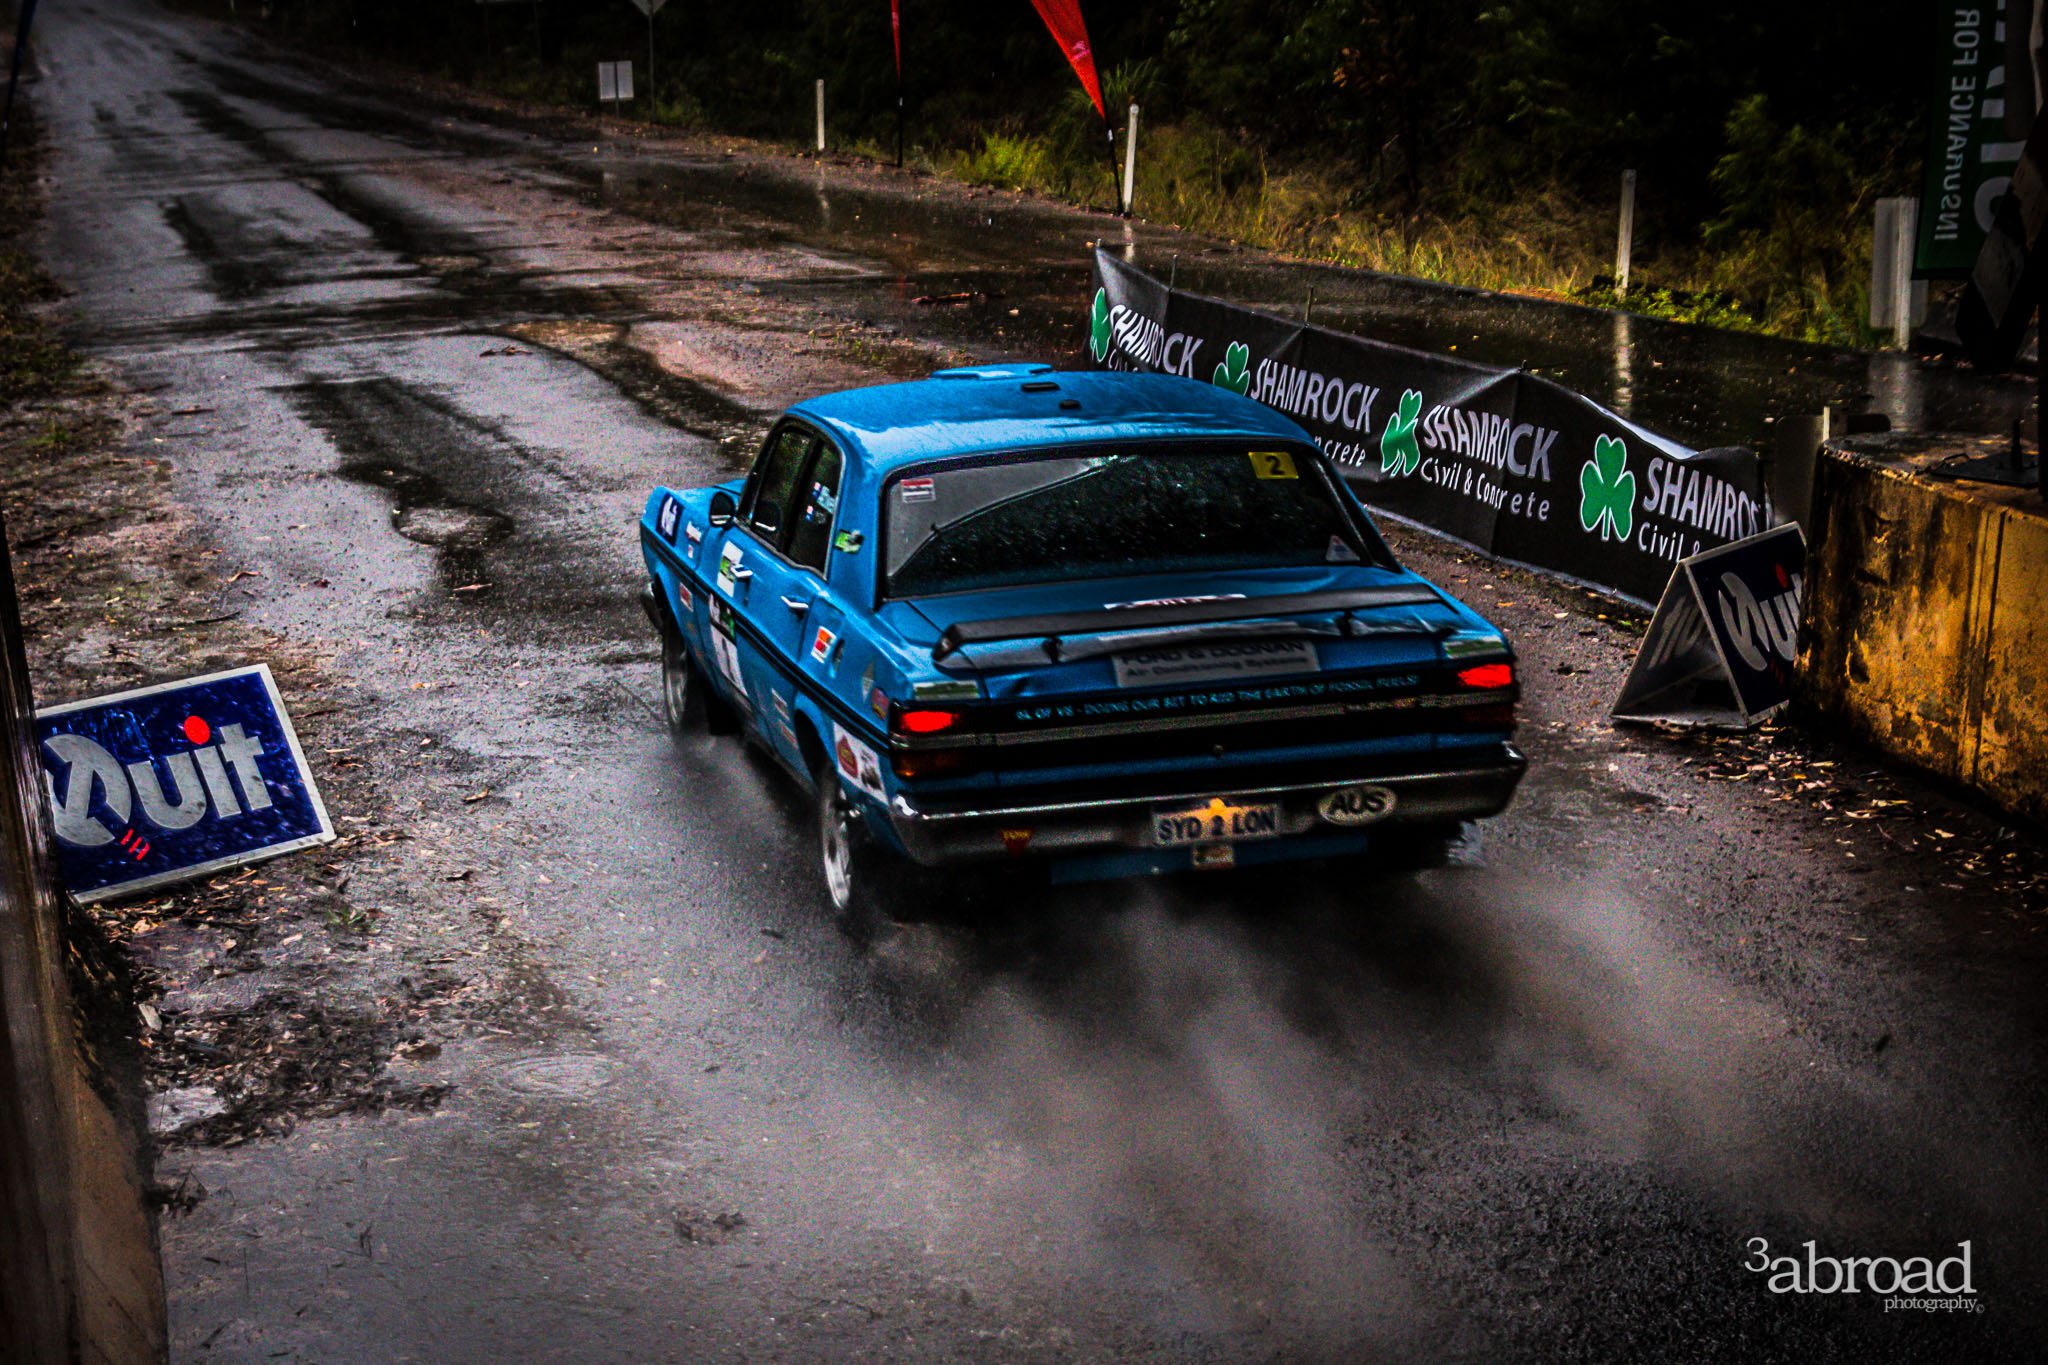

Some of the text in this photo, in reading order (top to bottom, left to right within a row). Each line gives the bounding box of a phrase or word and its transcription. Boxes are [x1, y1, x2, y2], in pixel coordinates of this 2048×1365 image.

[1110, 304, 1204, 379] SHAMROCK
[1251, 358, 1380, 434] SHAMROCK
[1265, 455, 1286, 476] 2
[1423, 404, 1559, 483] SHAMROCK
[1420, 457, 1550, 521] Civil & Concrete
[1639, 521, 1684, 565] Civil
[45, 716, 272, 846] Quit
[1328, 790, 1385, 815] AUS
[1159, 809, 1275, 841] SYD 2 LON
